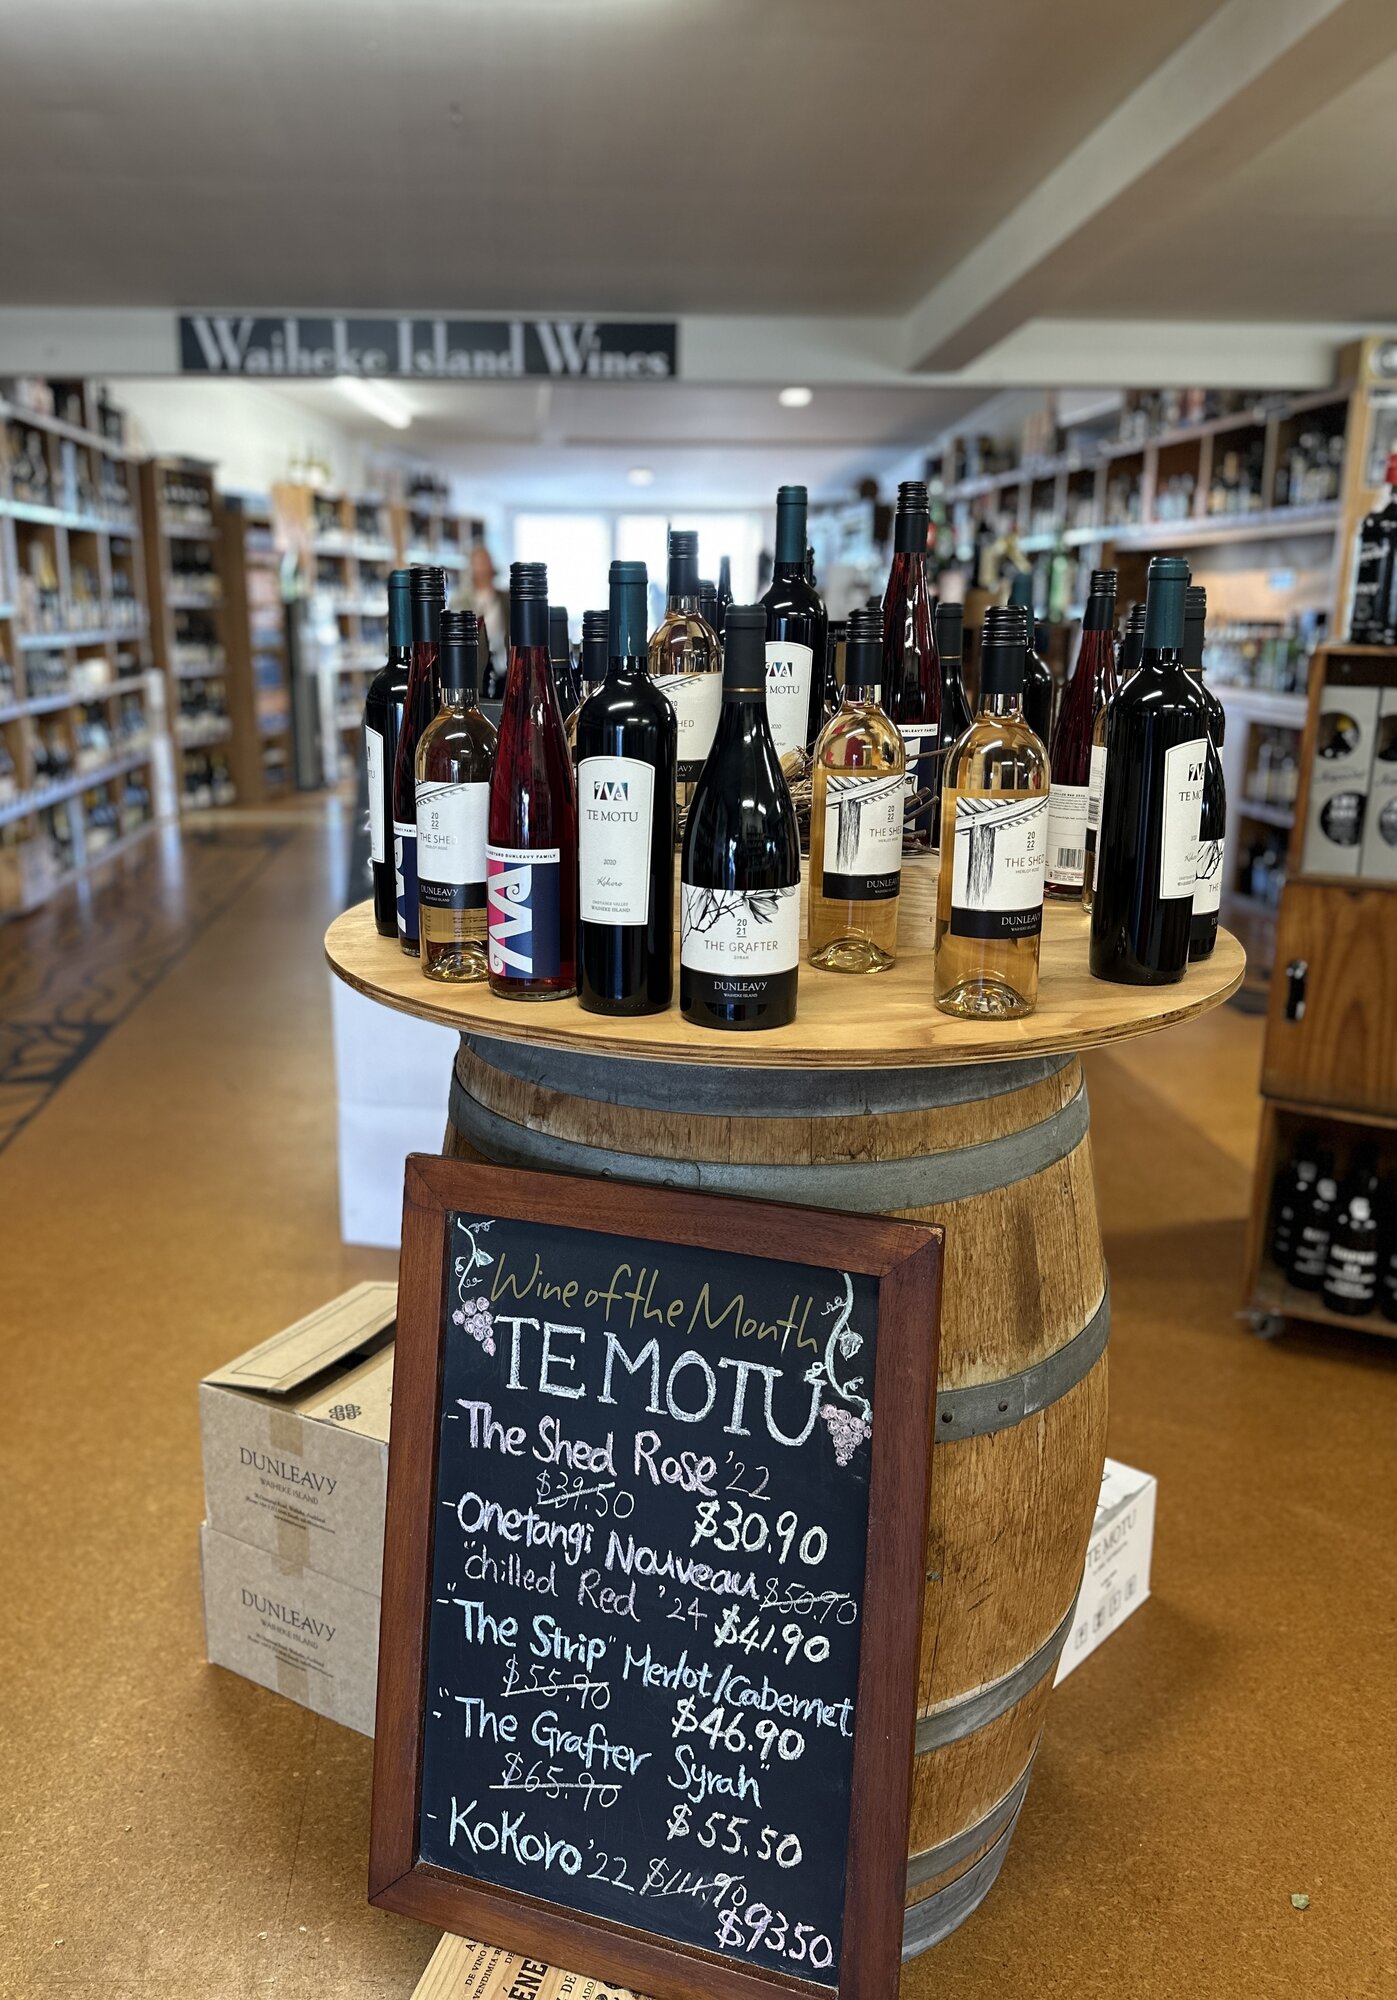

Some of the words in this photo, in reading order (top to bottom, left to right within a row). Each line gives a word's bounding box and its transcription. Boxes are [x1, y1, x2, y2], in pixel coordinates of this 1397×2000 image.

[190, 316, 390, 374] Waiheke
[398, 318, 525, 376] Island
[534, 320, 671, 379] Wines
[770, 685, 800, 694] MOTU
[1179, 791, 1191, 801] TE
[431, 811, 439, 819] 20
[586, 809, 599, 820] TE
[600, 811, 638, 822] MOTU
[420, 832, 431, 843] THE
[870, 828, 887, 838] THE
[1026, 840, 1035, 848] 22
[1027, 831, 1036, 839] 20
[1005, 857, 1026, 868] THE
[420, 884, 459, 897] DUNLEAVY
[736, 927, 746, 935] 21
[704, 939, 725, 951] THE
[728, 940, 779, 954] GRAFTER
[714, 981, 768, 991] DUNLEAVY
[490, 1252, 579, 1308] Wine
[584, 1263, 632, 1322] of
[624, 1267, 685, 1329] the
[686, 1282, 819, 1354] Month
[494, 1313, 588, 1400] TE
[597, 1330, 828, 1447] MOTU
[532, 1414, 618, 1477] Shed
[634, 1429, 720, 1497] Rose
[239, 1446, 338, 1496] DUNLEAVY
[689, 1499, 828, 1566] $30.90
[577, 1568, 641, 1623] Red
[242, 1587, 337, 1643] DUNLEAVY
[713, 1603, 831, 1666] $41.90
[671, 1694, 806, 1761] $46.90
[531, 1709, 653, 1776] Grafter
[666, 1802, 803, 1869] $55.50
[714, 1902, 835, 1969] $93.50
[465, 1973, 476, 1986] DE
[472, 1950, 487, 1971] VINO
[560, 1975, 577, 1994] DE
